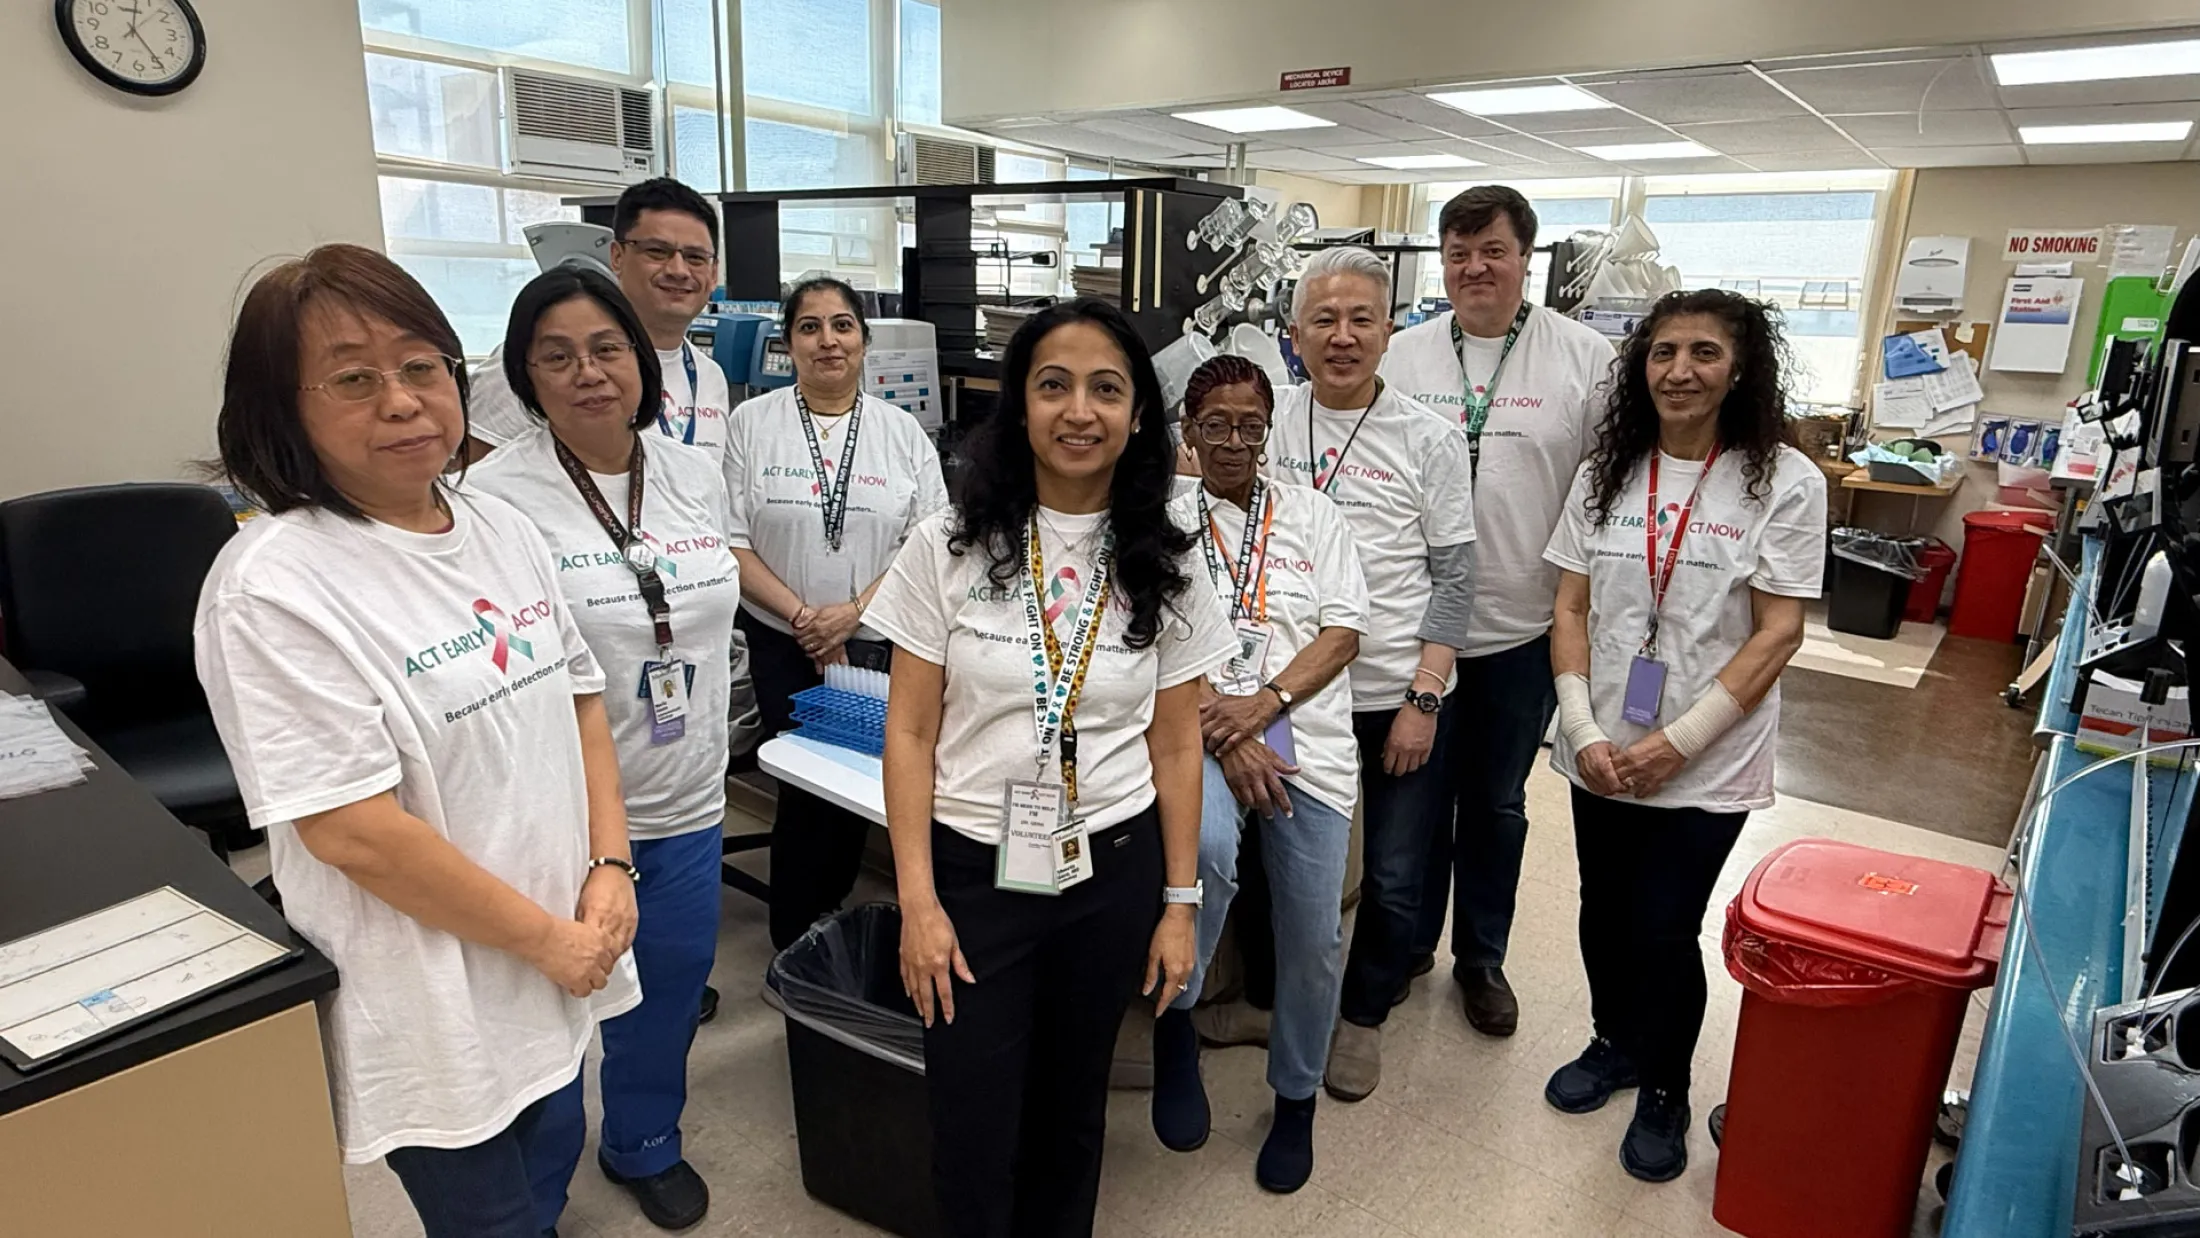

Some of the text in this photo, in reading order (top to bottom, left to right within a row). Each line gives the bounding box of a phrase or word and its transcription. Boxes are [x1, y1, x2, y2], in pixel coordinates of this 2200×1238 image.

[89, 1, 108, 15] 10
[158, 9, 170, 23] 2
[87, 17, 100, 30] 9
[95, 35, 109, 49] 8
[166, 29, 177, 41] 3
[112, 50, 123, 63] 7
[164, 47, 175, 57] 4
[133, 60, 145, 72] 6
[151, 56, 165, 69] 5
[1284, 69, 1343, 80] MECHANICAL DEVICE
[2008, 236, 2029, 253] NO
[2032, 236, 2098, 253] SMOKING
[1510, 397, 1543, 408] NOW
[762, 466, 816, 480] ACT EARLY
[1338, 463, 1360, 476] ACT
[1360, 468, 1395, 483] NOW
[857, 475, 887, 487] NOW
[1621, 515, 1646, 528] EAR
[1688, 522, 1746, 541] CT NOW
[666, 540, 692, 555] ACT
[560, 551, 627, 571] ACT EAR
[1266, 557, 1288, 570] ACT
[1626, 552, 1646, 562] early
[663, 582, 696, 596] ection
[586, 592, 643, 607] Because ear
[405, 646, 442, 678] ACT
[441, 628, 487, 660] EARLY
[511, 606, 535, 631] AC
[1030, 632, 1043, 650] ON
[1060, 667, 1073, 684] BE
[1067, 618, 1089, 667] STRONG
[445, 697, 487, 723] Because
[511, 665, 555, 692] detection
[2090, 704, 2123, 718] Tecan
